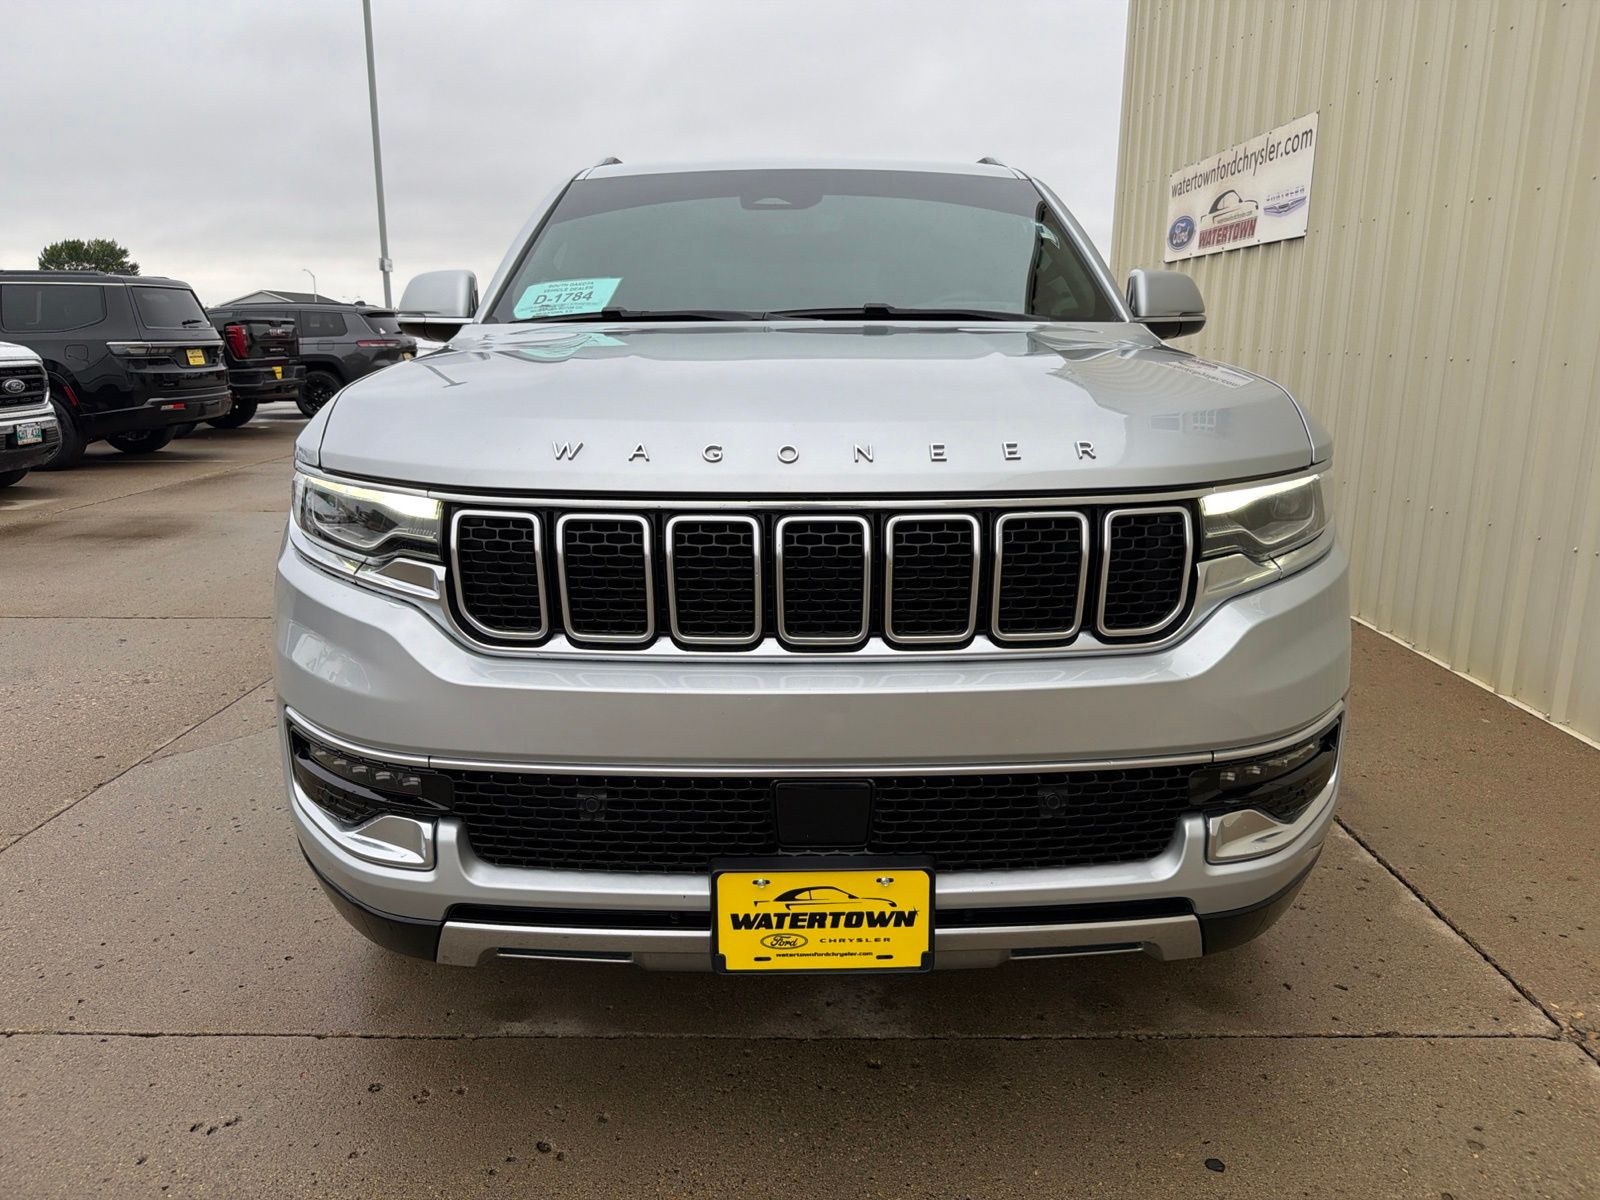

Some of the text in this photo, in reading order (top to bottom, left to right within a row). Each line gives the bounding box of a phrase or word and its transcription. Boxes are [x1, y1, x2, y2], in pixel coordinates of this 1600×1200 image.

[1171, 127, 1313, 198] watertownfordchrysler.com
[1172, 222, 1189, 244] Ford
[1198, 216, 1258, 249] WATERTOWN
[533, 291, 594, 305] D-1784
[552, 440, 1097, 463] WAGONEER
[730, 910, 917, 930] WATERTOWN
[770, 936, 798, 948] Ford
[776, 951, 873, 959] watertownfordchrysler.com
